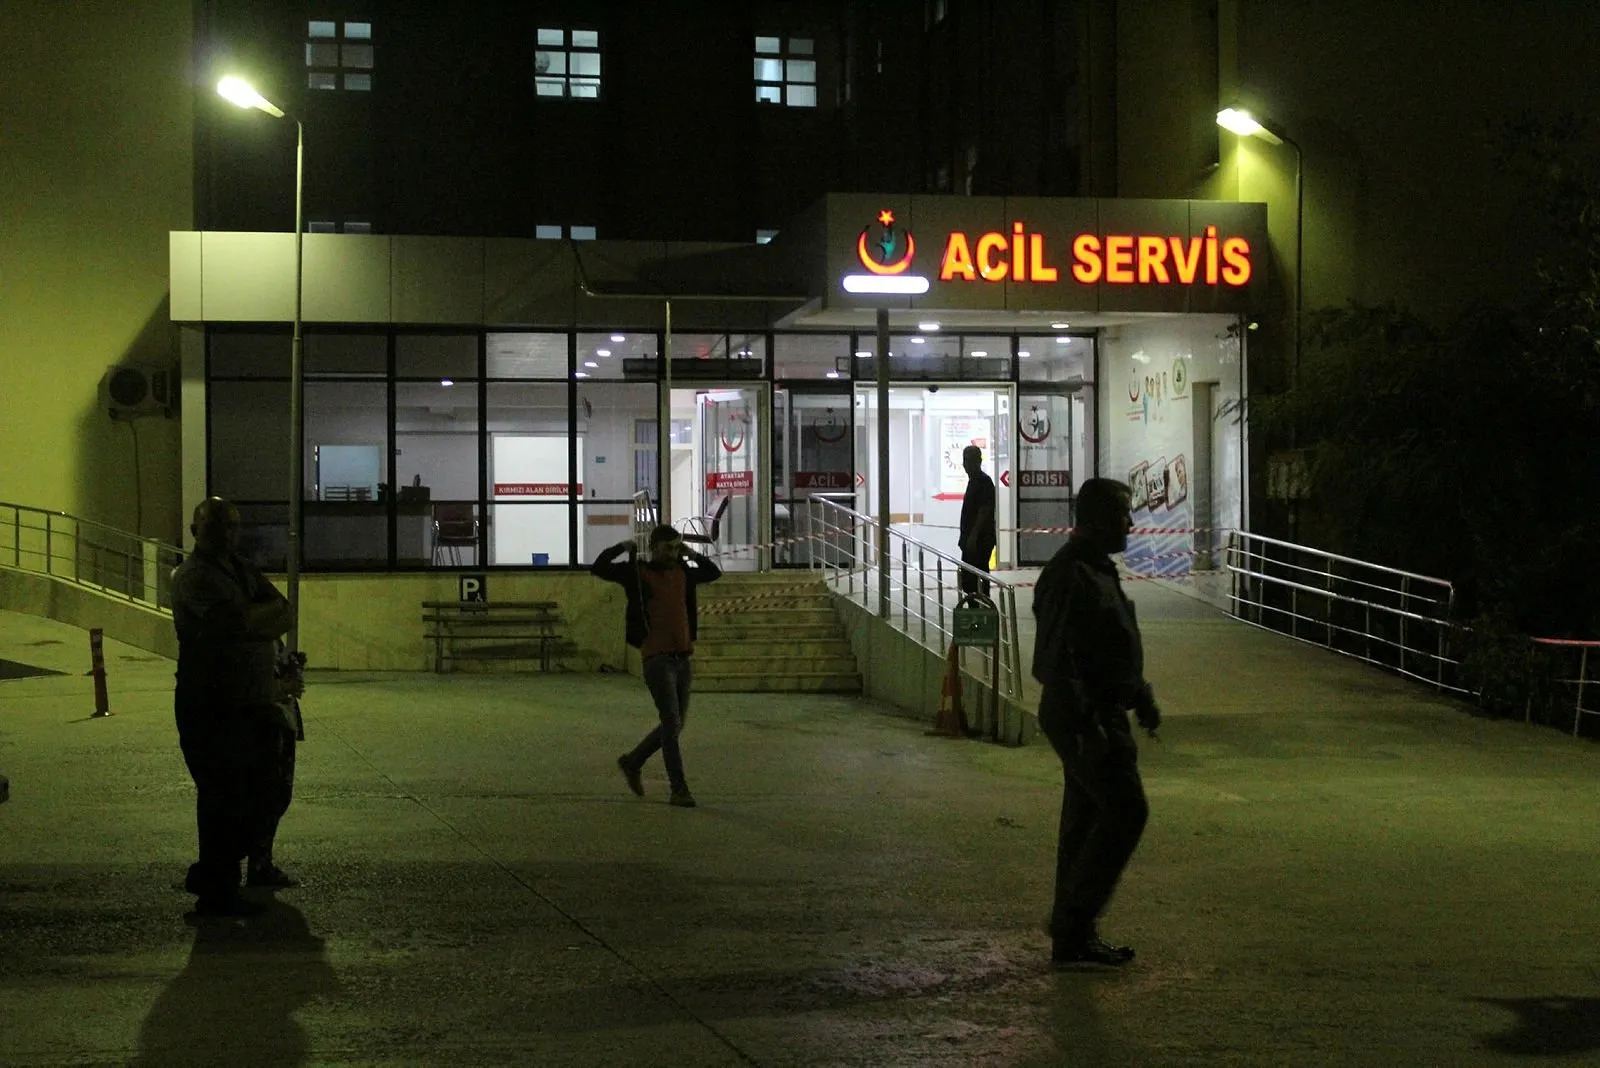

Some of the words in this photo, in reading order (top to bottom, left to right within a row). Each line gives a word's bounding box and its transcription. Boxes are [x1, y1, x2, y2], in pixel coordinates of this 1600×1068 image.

[939, 222, 1057, 282] ACİL
[1071, 225, 1251, 286] SERVİS
[808, 472, 840, 487] ACİL
[499, 486, 525, 494] KIRMIZI
[525, 486, 544, 494] ALAN
[545, 485, 568, 494] GİRİLM
[463, 579, 480, 600] P
